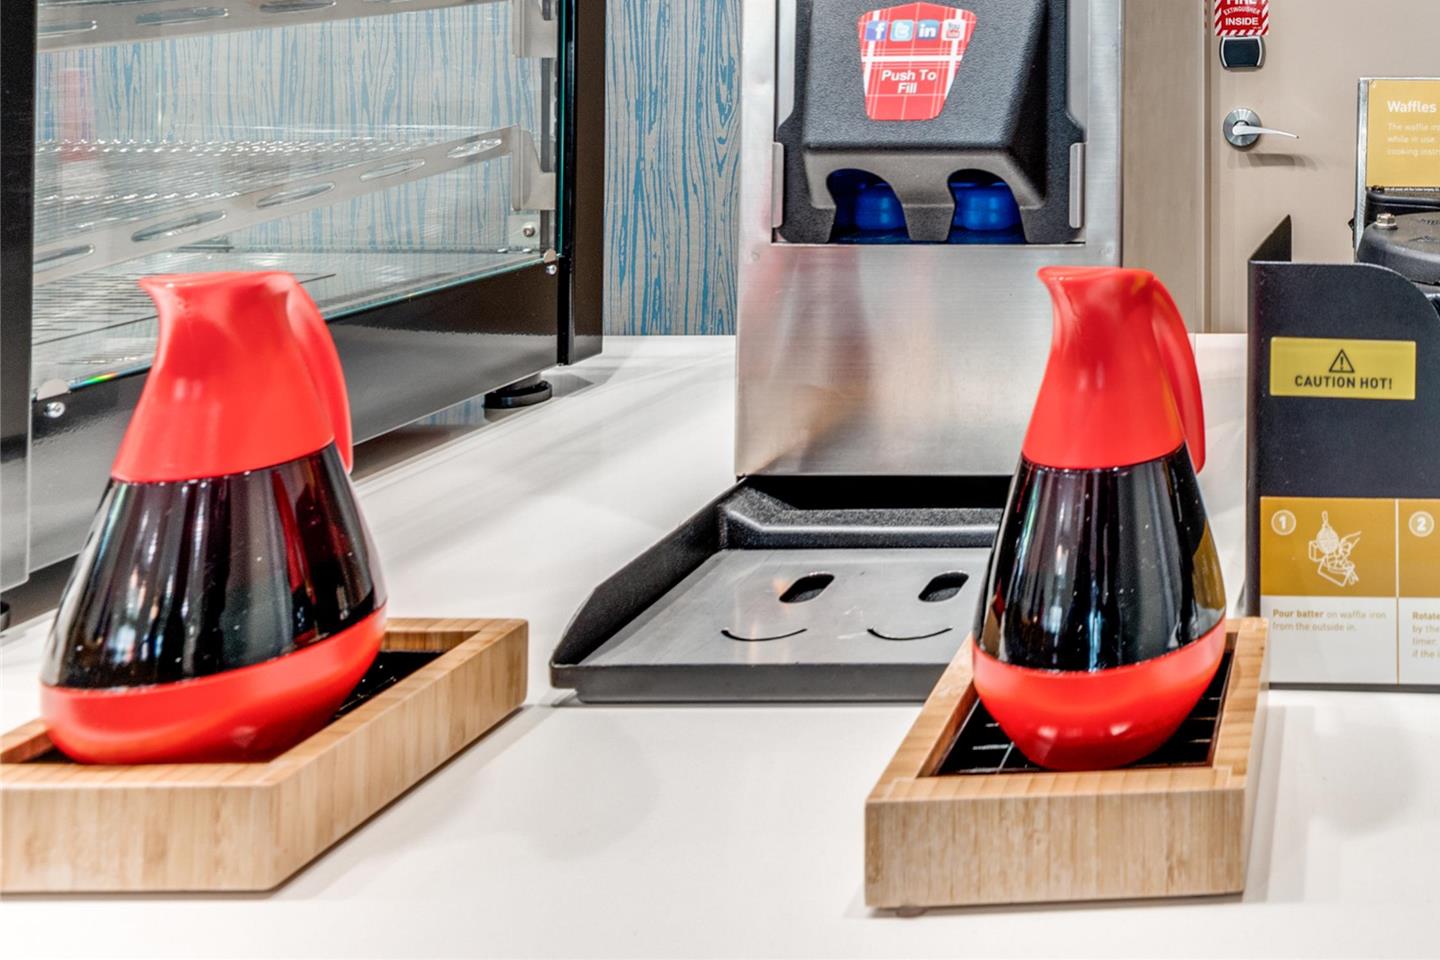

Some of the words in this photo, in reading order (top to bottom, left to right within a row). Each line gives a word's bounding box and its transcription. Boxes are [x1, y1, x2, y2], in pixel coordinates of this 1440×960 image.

[1225, 17, 1259, 26] INSIDE
[918, 22, 937, 39] in
[881, 69, 916, 81] Push
[920, 69, 937, 81] To
[897, 83, 917, 94] Fill
[1387, 100, 1437, 113] Waffles
[1294, 375, 1355, 388] CAUTION
[1360, 377, 1392, 390] HOT!
[1278, 516, 1287, 529] 1
[1416, 517, 1426, 530] 2
[1272, 609, 1293, 618] Pour
[1296, 609, 1324, 618] batter
[1412, 612, 1440, 620] Rotate
